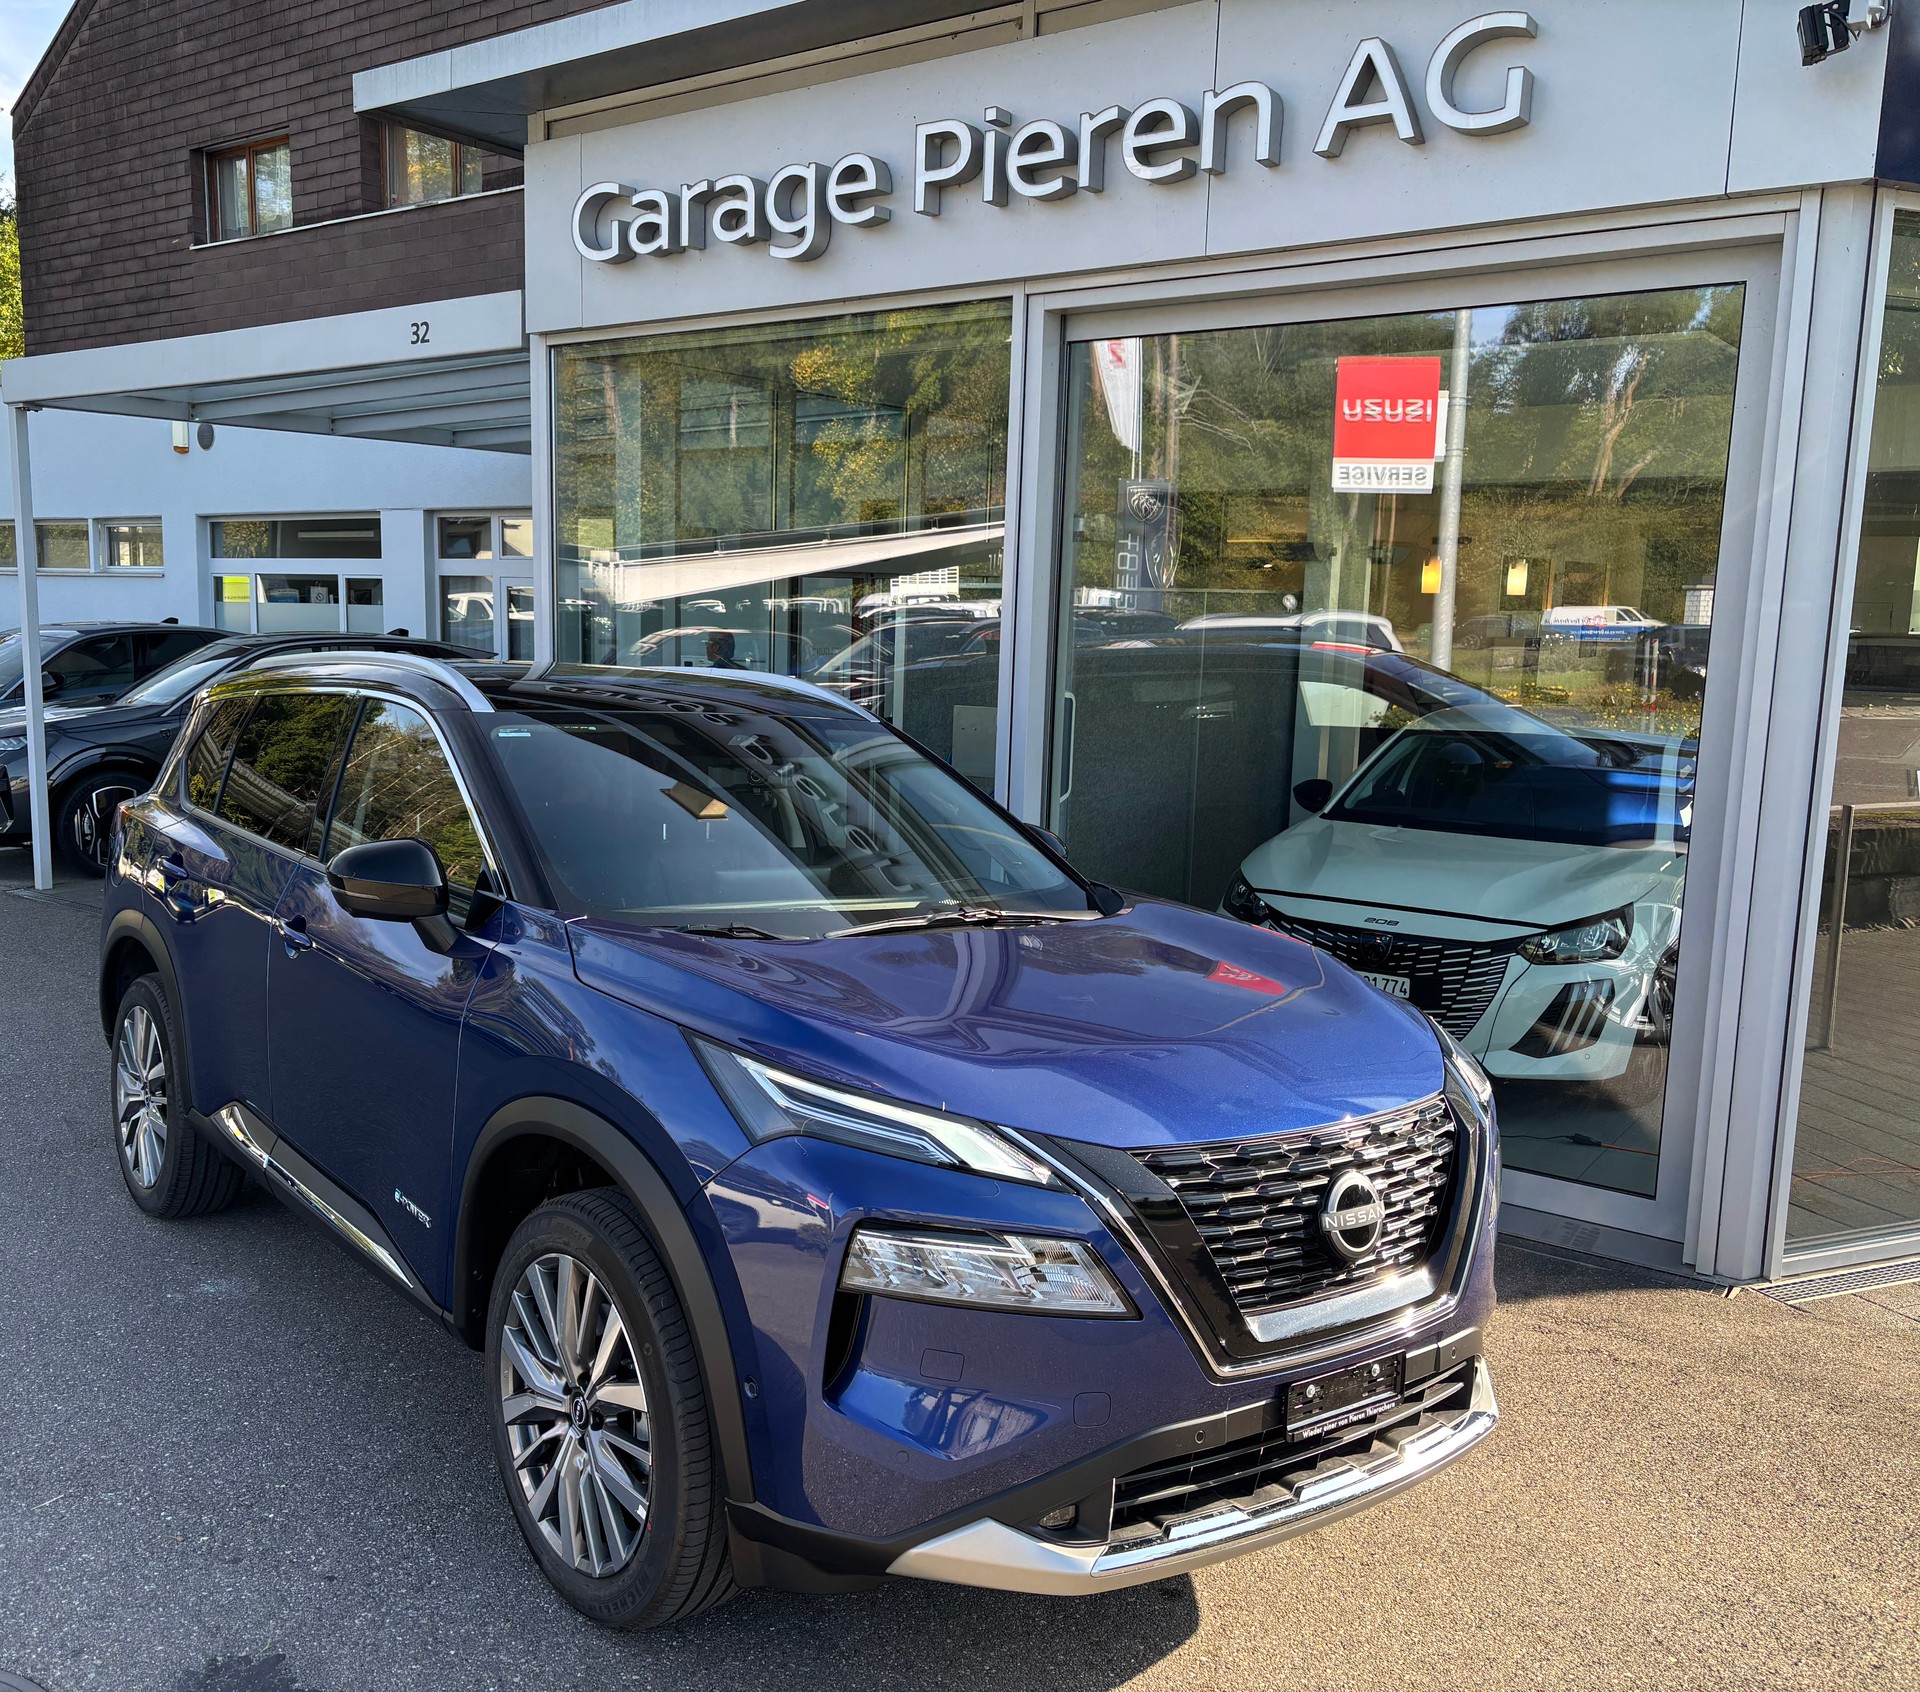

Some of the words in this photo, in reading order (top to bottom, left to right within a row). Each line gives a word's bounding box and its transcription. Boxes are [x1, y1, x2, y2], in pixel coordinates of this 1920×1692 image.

[572, 152, 892, 264] Garage
[914, 81, 1282, 216] Pieren
[1312, 11, 1537, 158] AG
[411, 321, 429, 344] 32
[1364, 917, 1400, 926] 208
[1324, 1205, 1385, 1229] NISSAN
[1302, 1427, 1323, 1438] Wieder
[1323, 1422, 1338, 1432] einer
[1338, 1418, 1348, 1427] von
[1349, 1411, 1366, 1423] Pieren
